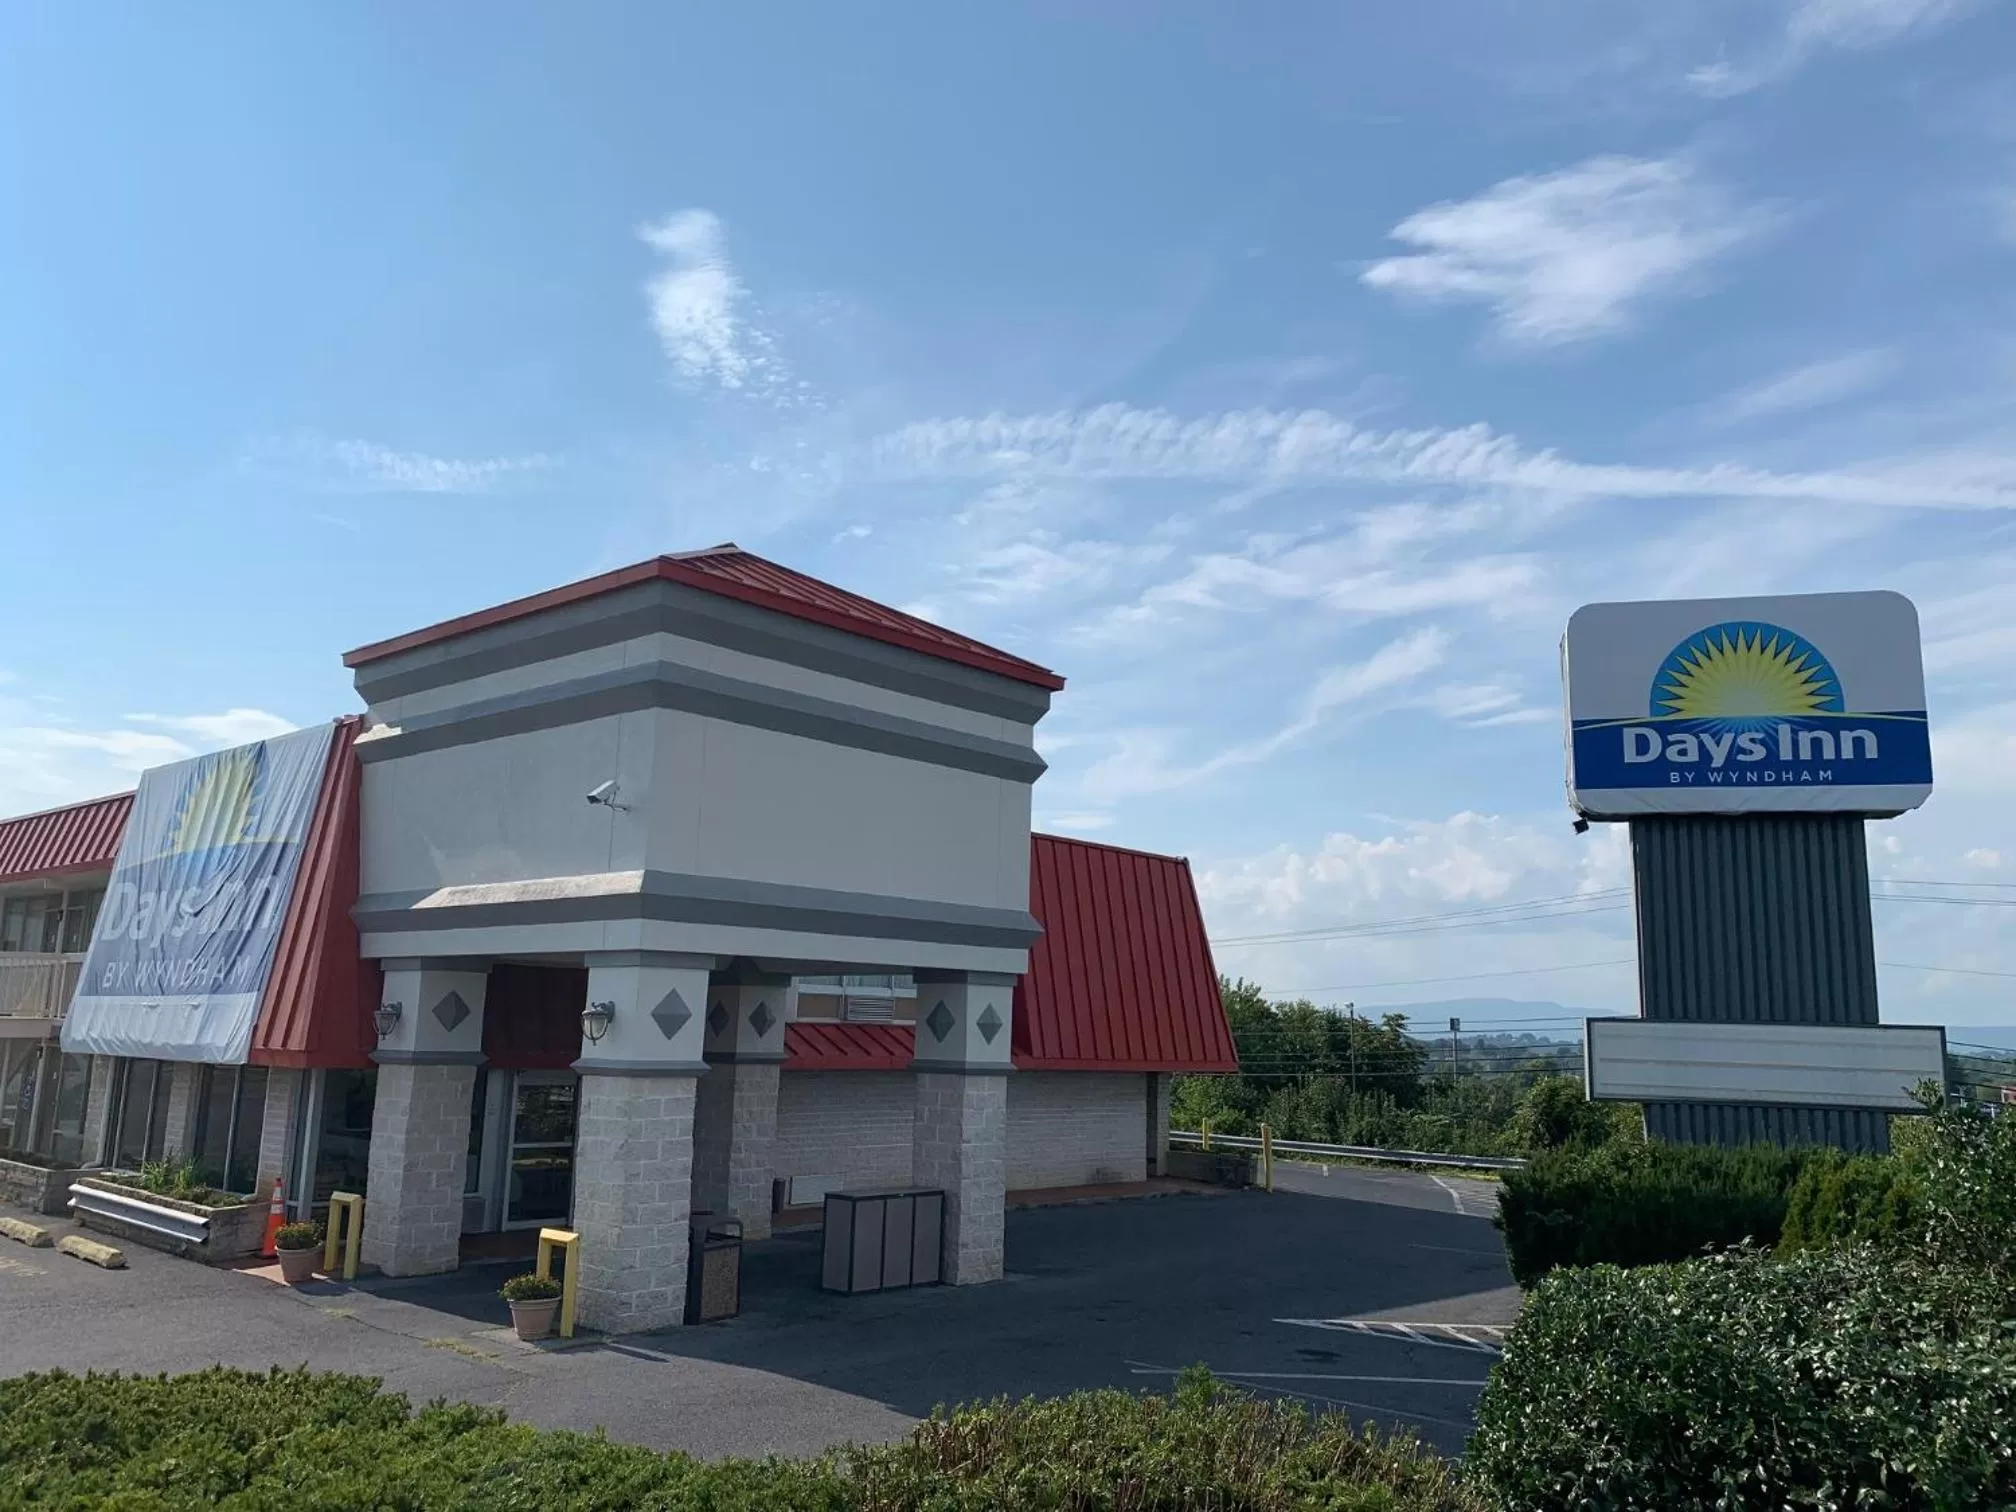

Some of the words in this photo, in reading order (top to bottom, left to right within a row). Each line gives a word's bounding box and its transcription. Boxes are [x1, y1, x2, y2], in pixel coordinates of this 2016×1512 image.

[1623, 726, 1767, 767] Days
[1778, 724, 1879, 761] Inn
[1670, 771, 1696, 783] BY
[1708, 770, 1833, 782] WYNDHAM
[101, 882, 200, 948] Days
[102, 961, 129, 988] BY
[135, 956, 250, 990] WYNDHAM
